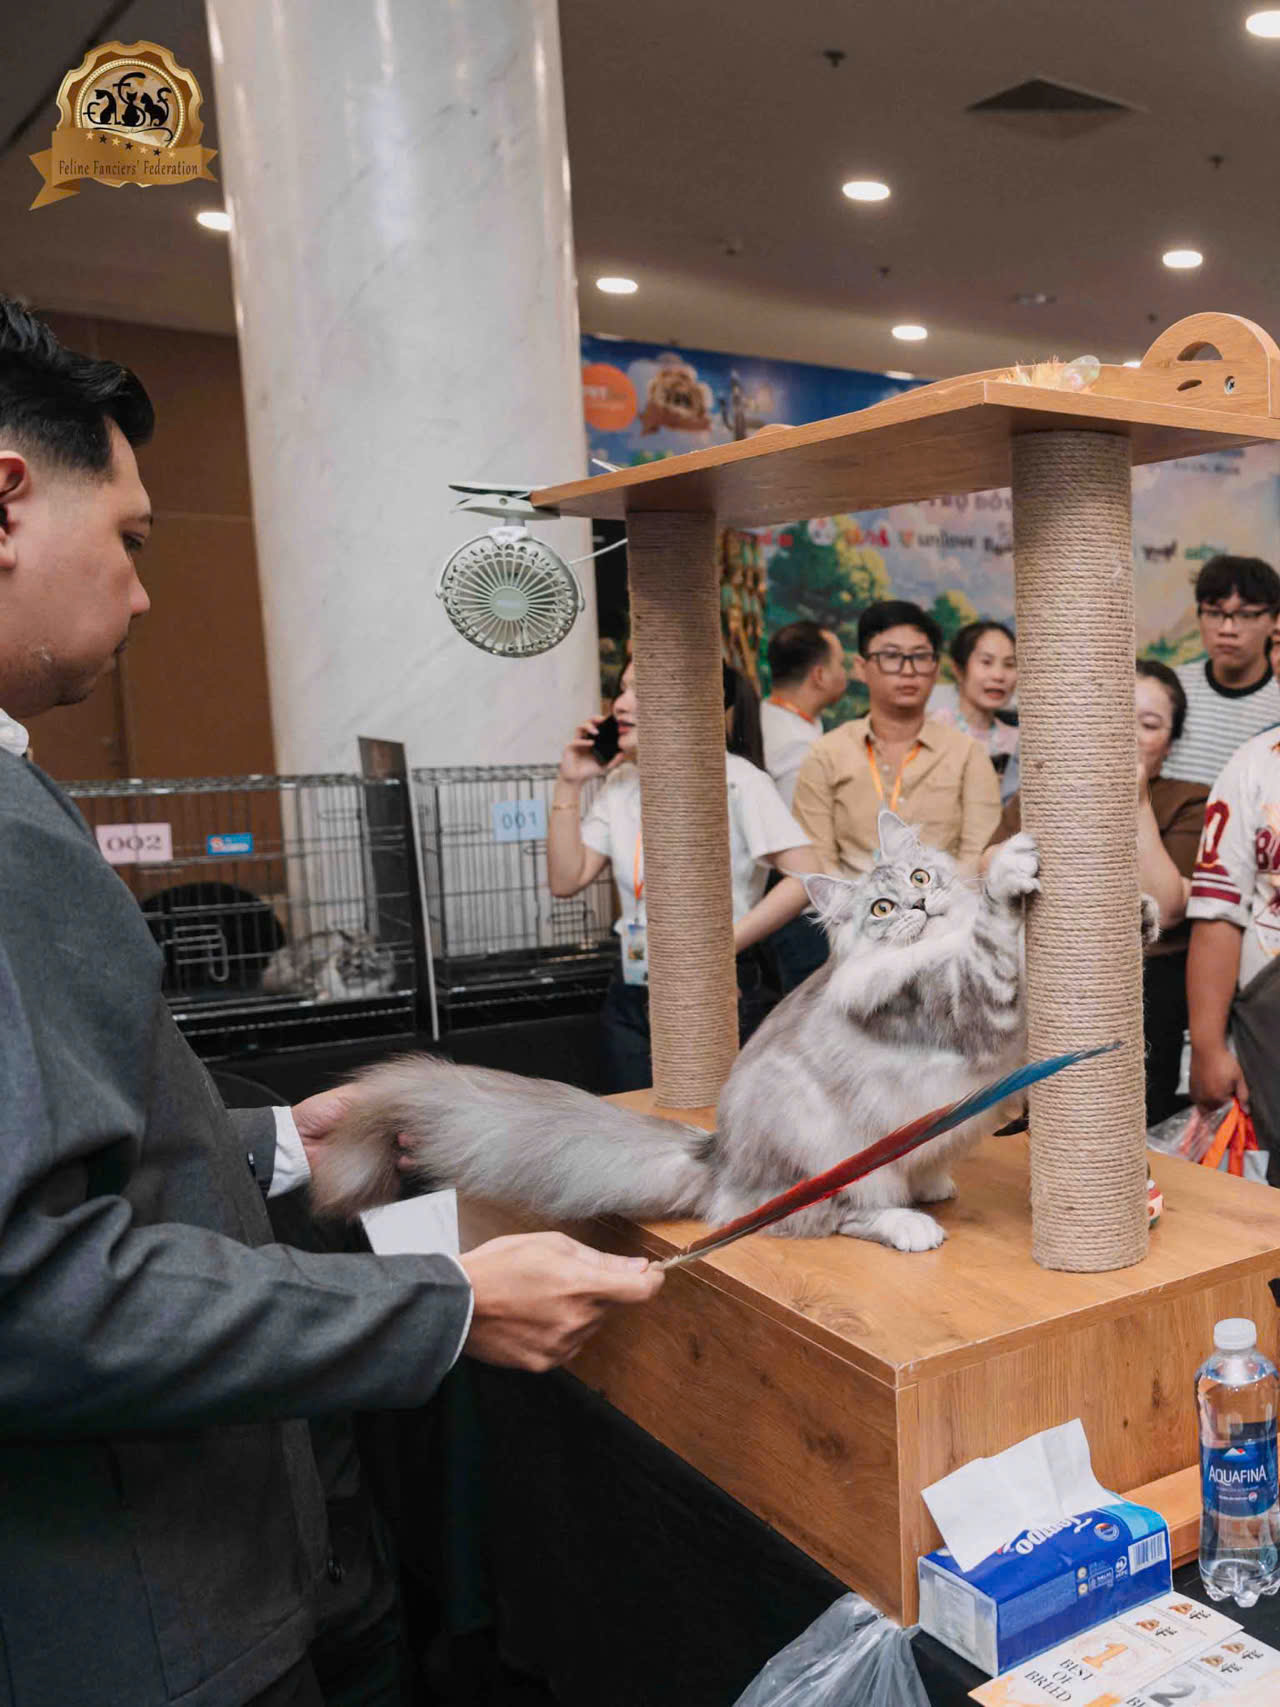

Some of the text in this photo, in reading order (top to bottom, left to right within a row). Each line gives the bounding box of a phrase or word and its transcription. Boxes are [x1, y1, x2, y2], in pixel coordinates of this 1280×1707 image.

[107, 834, 162, 851] 002
[1208, 1464, 1267, 1486] AQUAFINA
[1052, 1670, 1074, 1686] OF
[1059, 1658, 1094, 1681] BEST
[1024, 1669, 1072, 1703] BREED
